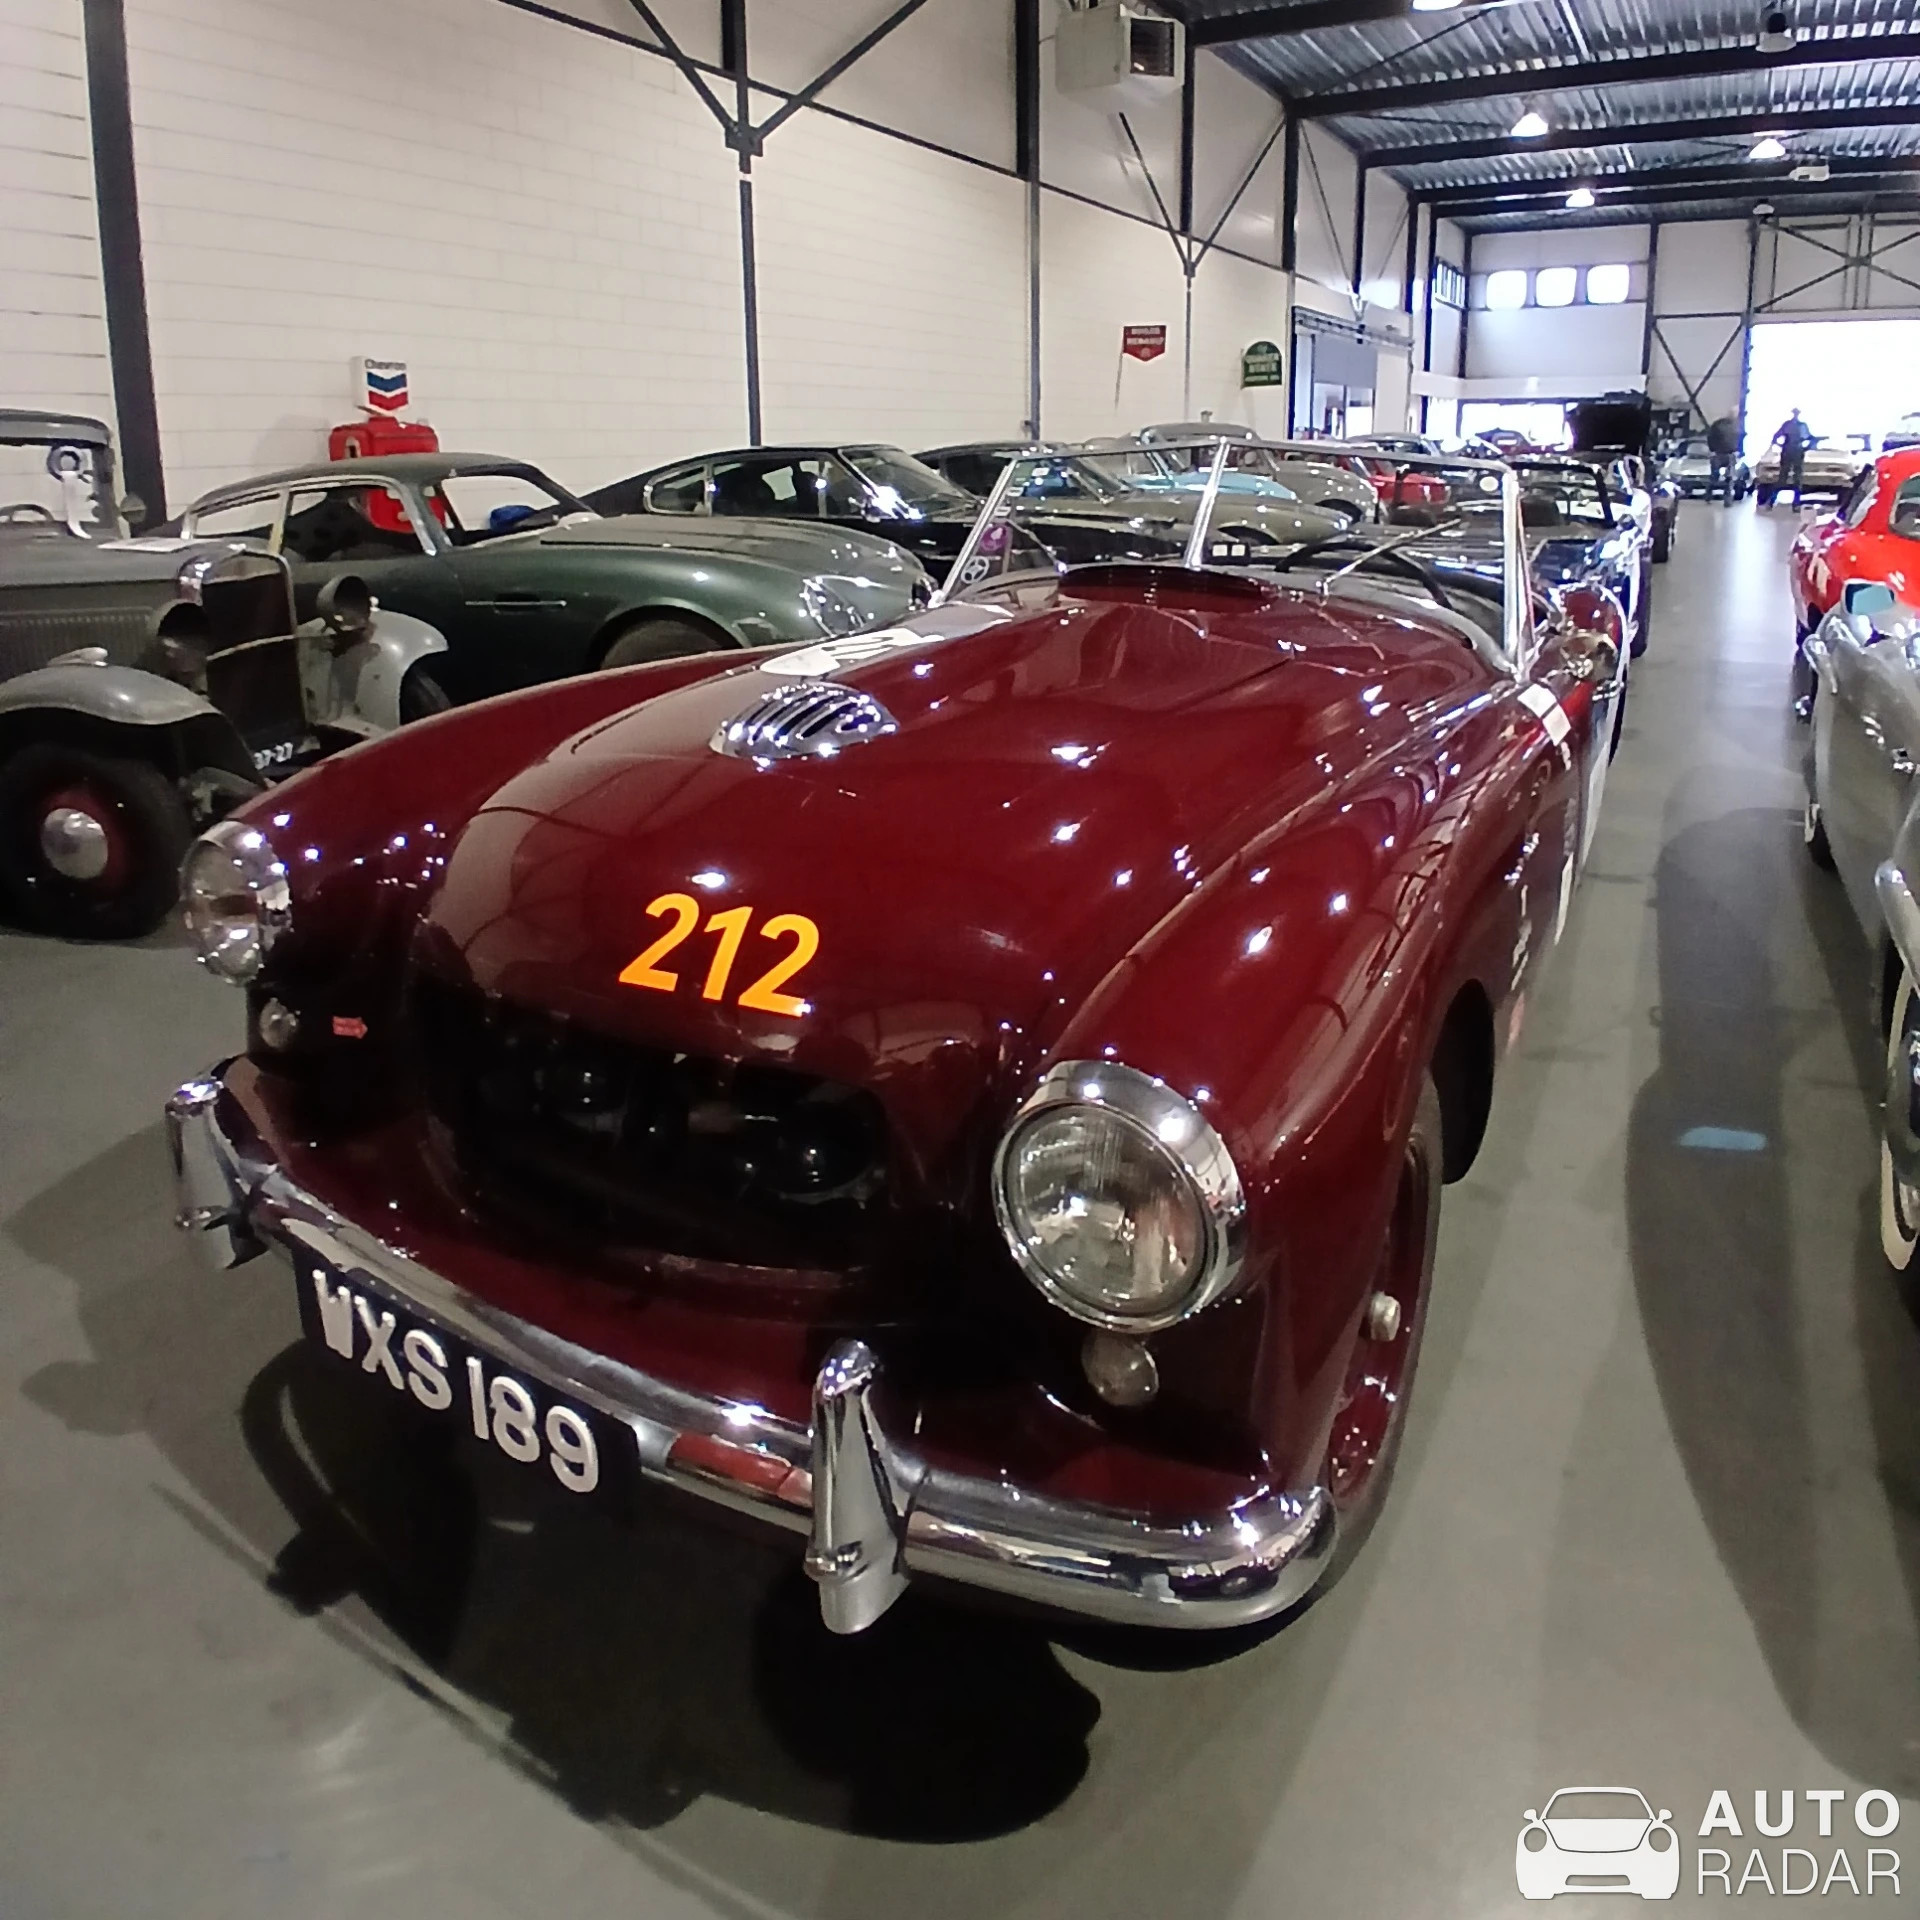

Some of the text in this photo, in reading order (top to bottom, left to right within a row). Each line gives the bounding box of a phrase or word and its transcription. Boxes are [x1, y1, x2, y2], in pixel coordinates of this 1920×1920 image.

[618, 892, 820, 1017] 212
[312, 1268, 599, 1493] WXS 189
